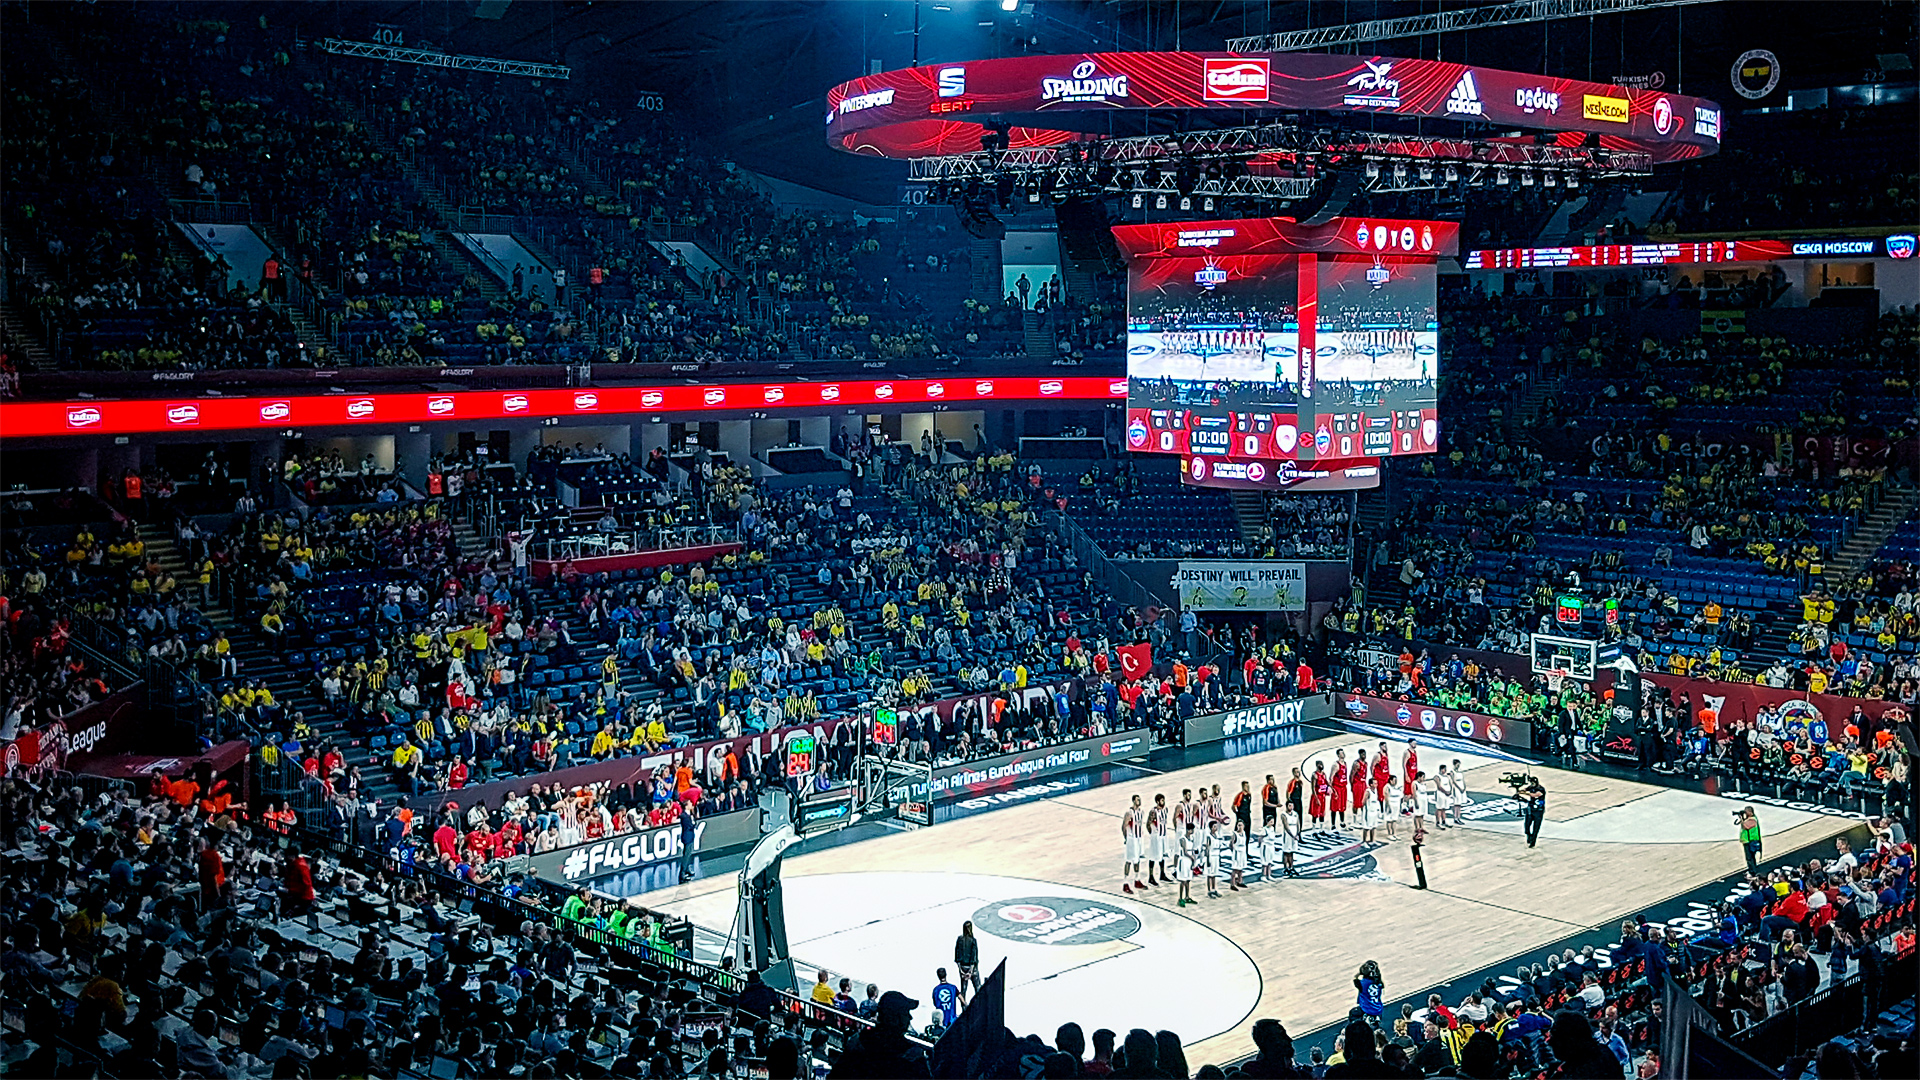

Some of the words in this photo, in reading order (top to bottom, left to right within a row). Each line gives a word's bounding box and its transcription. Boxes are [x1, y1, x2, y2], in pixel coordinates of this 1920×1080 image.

[371, 28, 405, 46] 404
[1042, 75, 1128, 99] SPALDING
[636, 95, 664, 111] 403
[930, 100, 974, 114] SEAT
[1446, 99, 1482, 115] adidas
[1792, 243, 1823, 255] CSKA
[1824, 241, 1874, 254] MOSCOW
[1160, 431, 1174, 451] 0
[1191, 431, 1229, 445] 10:00
[1244, 435, 1259, 455] 0
[1340, 436, 1352, 456] 0
[1364, 431, 1392, 445] 10:00
[1401, 432, 1412, 452] 0
[1181, 569, 1224, 581] DESTINY
[1228, 570, 1255, 581] WILL
[1258, 568, 1302, 581] PREVAIL
[1223, 699, 1305, 736] #F4GLORY
[873, 721, 895, 744] 24
[786, 753, 810, 776] 24
[911, 775, 949, 797] Turkish
[950, 769, 988, 788] Airlines
[1045, 751, 1068, 768] Final
[1069, 749, 1090, 763] Four
[562, 820, 707, 880] #F4GLORY
[1014, 906, 1109, 938] TURKISH
[941, 1002, 952, 1011] TV
